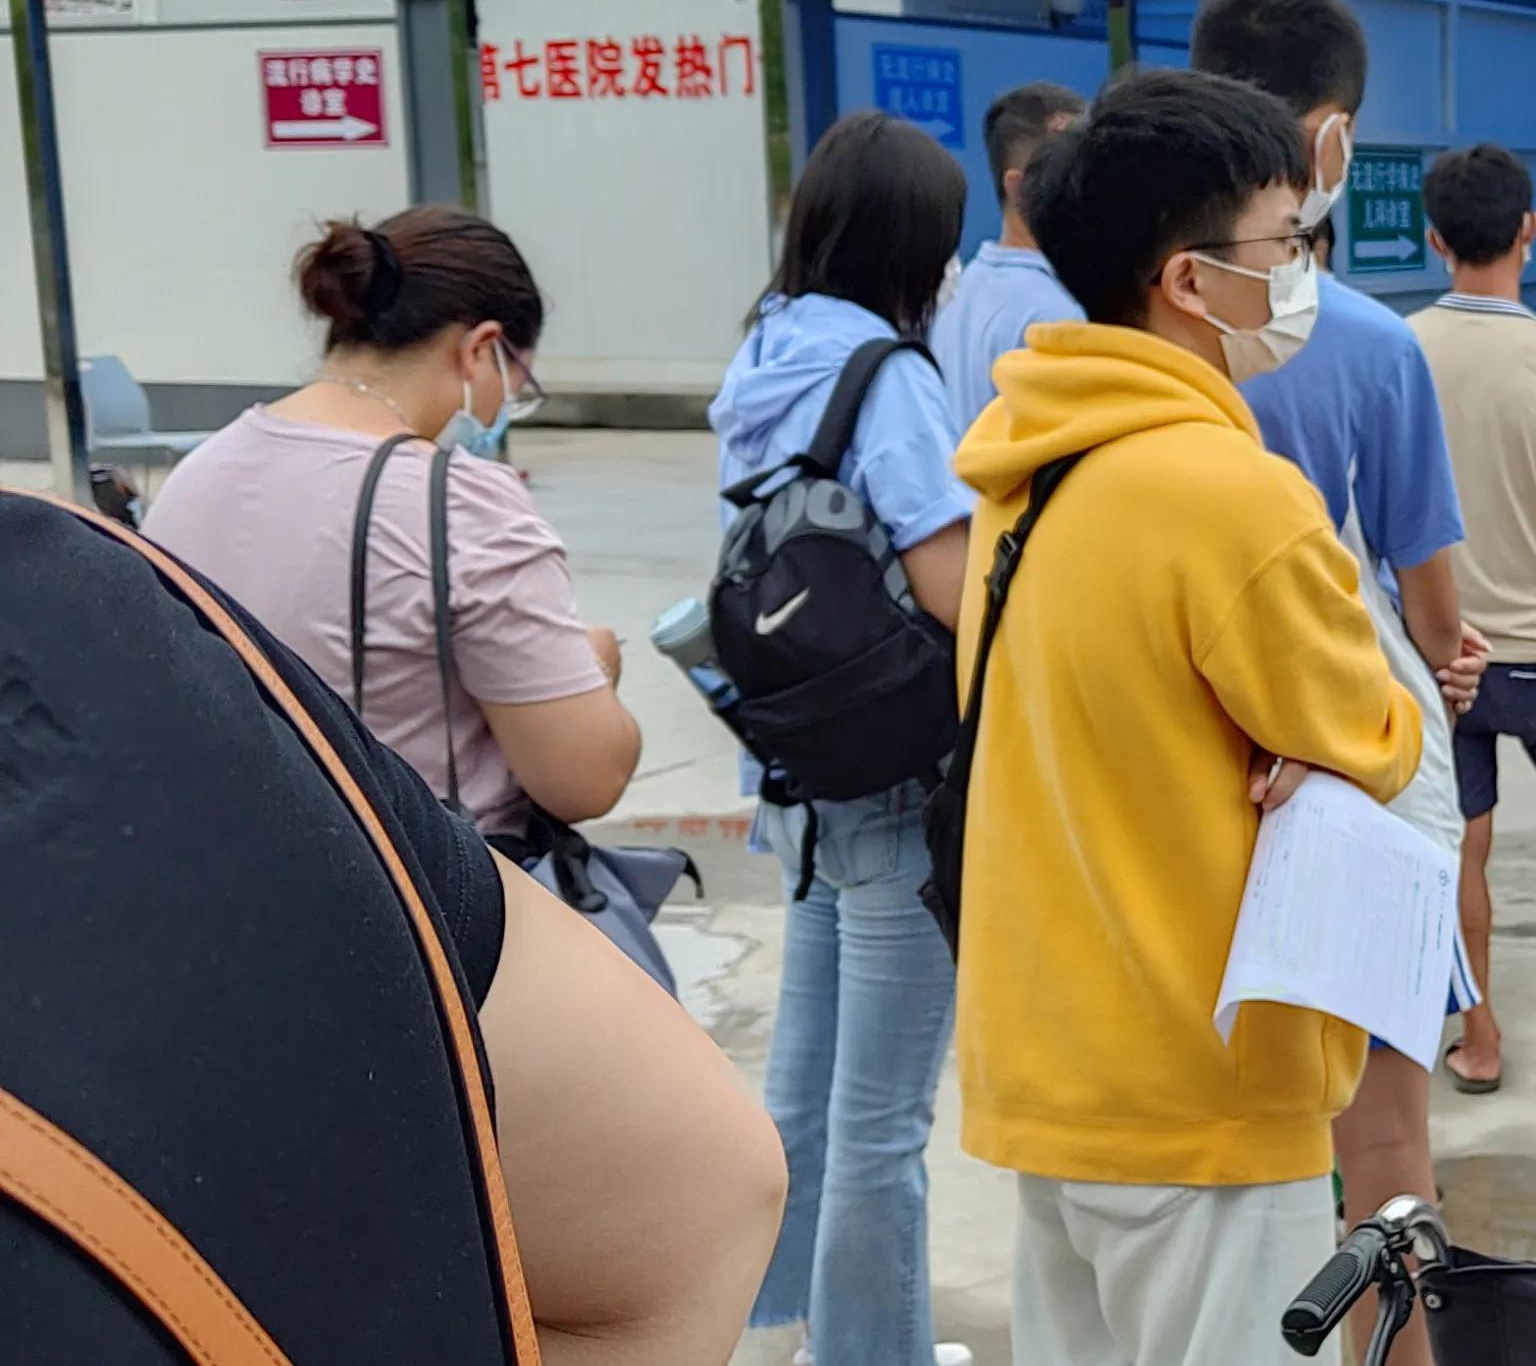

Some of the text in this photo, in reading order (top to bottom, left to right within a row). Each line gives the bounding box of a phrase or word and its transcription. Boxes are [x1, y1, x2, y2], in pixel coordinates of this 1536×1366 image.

[479, 33, 756, 99] 第七医院发热门
